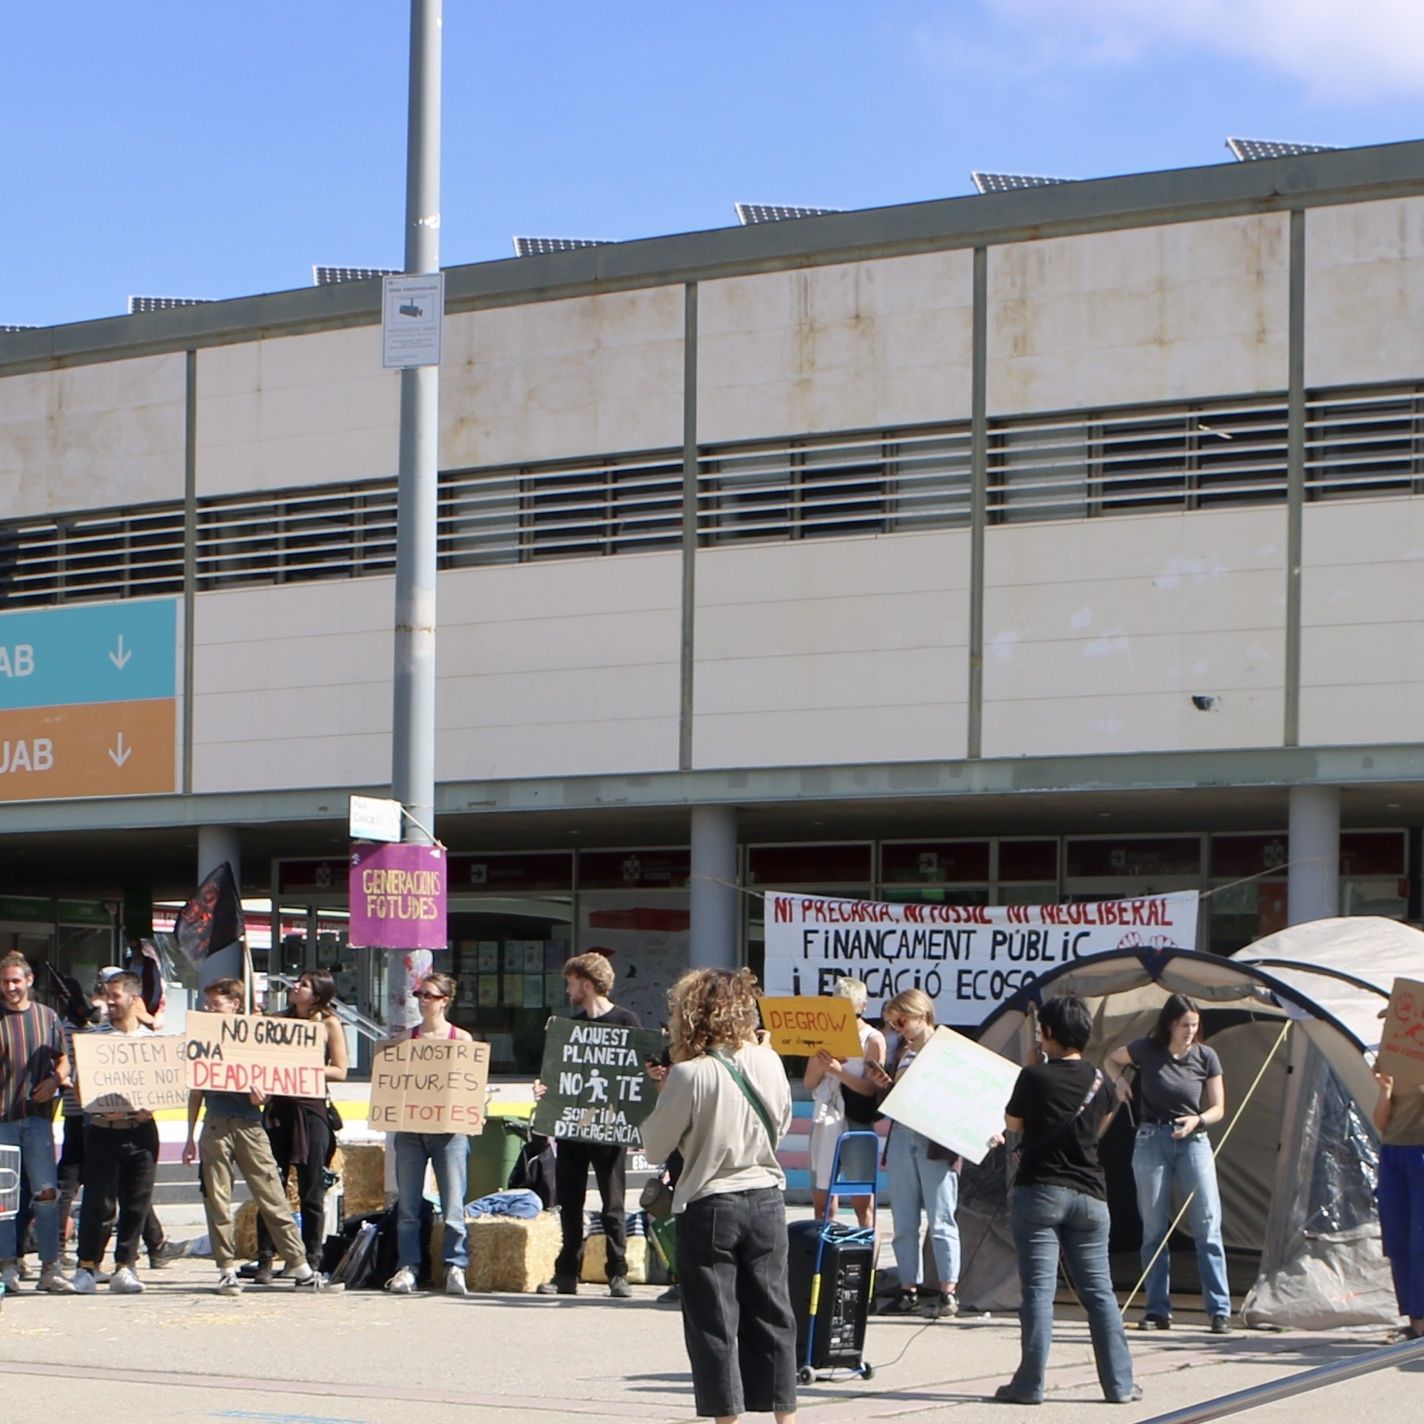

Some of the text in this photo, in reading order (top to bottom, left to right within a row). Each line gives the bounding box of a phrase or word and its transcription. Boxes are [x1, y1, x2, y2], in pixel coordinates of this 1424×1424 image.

[367, 896, 438, 920] FOTUDES
[1039, 897, 1173, 926] NEOLIBERAL
[769, 1010, 847, 1033] DEGROW
[222, 1019, 317, 1048] NO GROWTH
[569, 1025, 630, 1047] AQUEST
[96, 1042, 167, 1065] SYSTEM
[384, 1044, 486, 1063] EL NOSTRE
[562, 1045, 639, 1067] PLANETA
[93, 1068, 180, 1087] CHANGE NOT
[193, 1061, 325, 1095] DEAD PLANET
[559, 1071, 645, 1102] NO TÉ
[371, 1104, 481, 1126] DE TOTES
